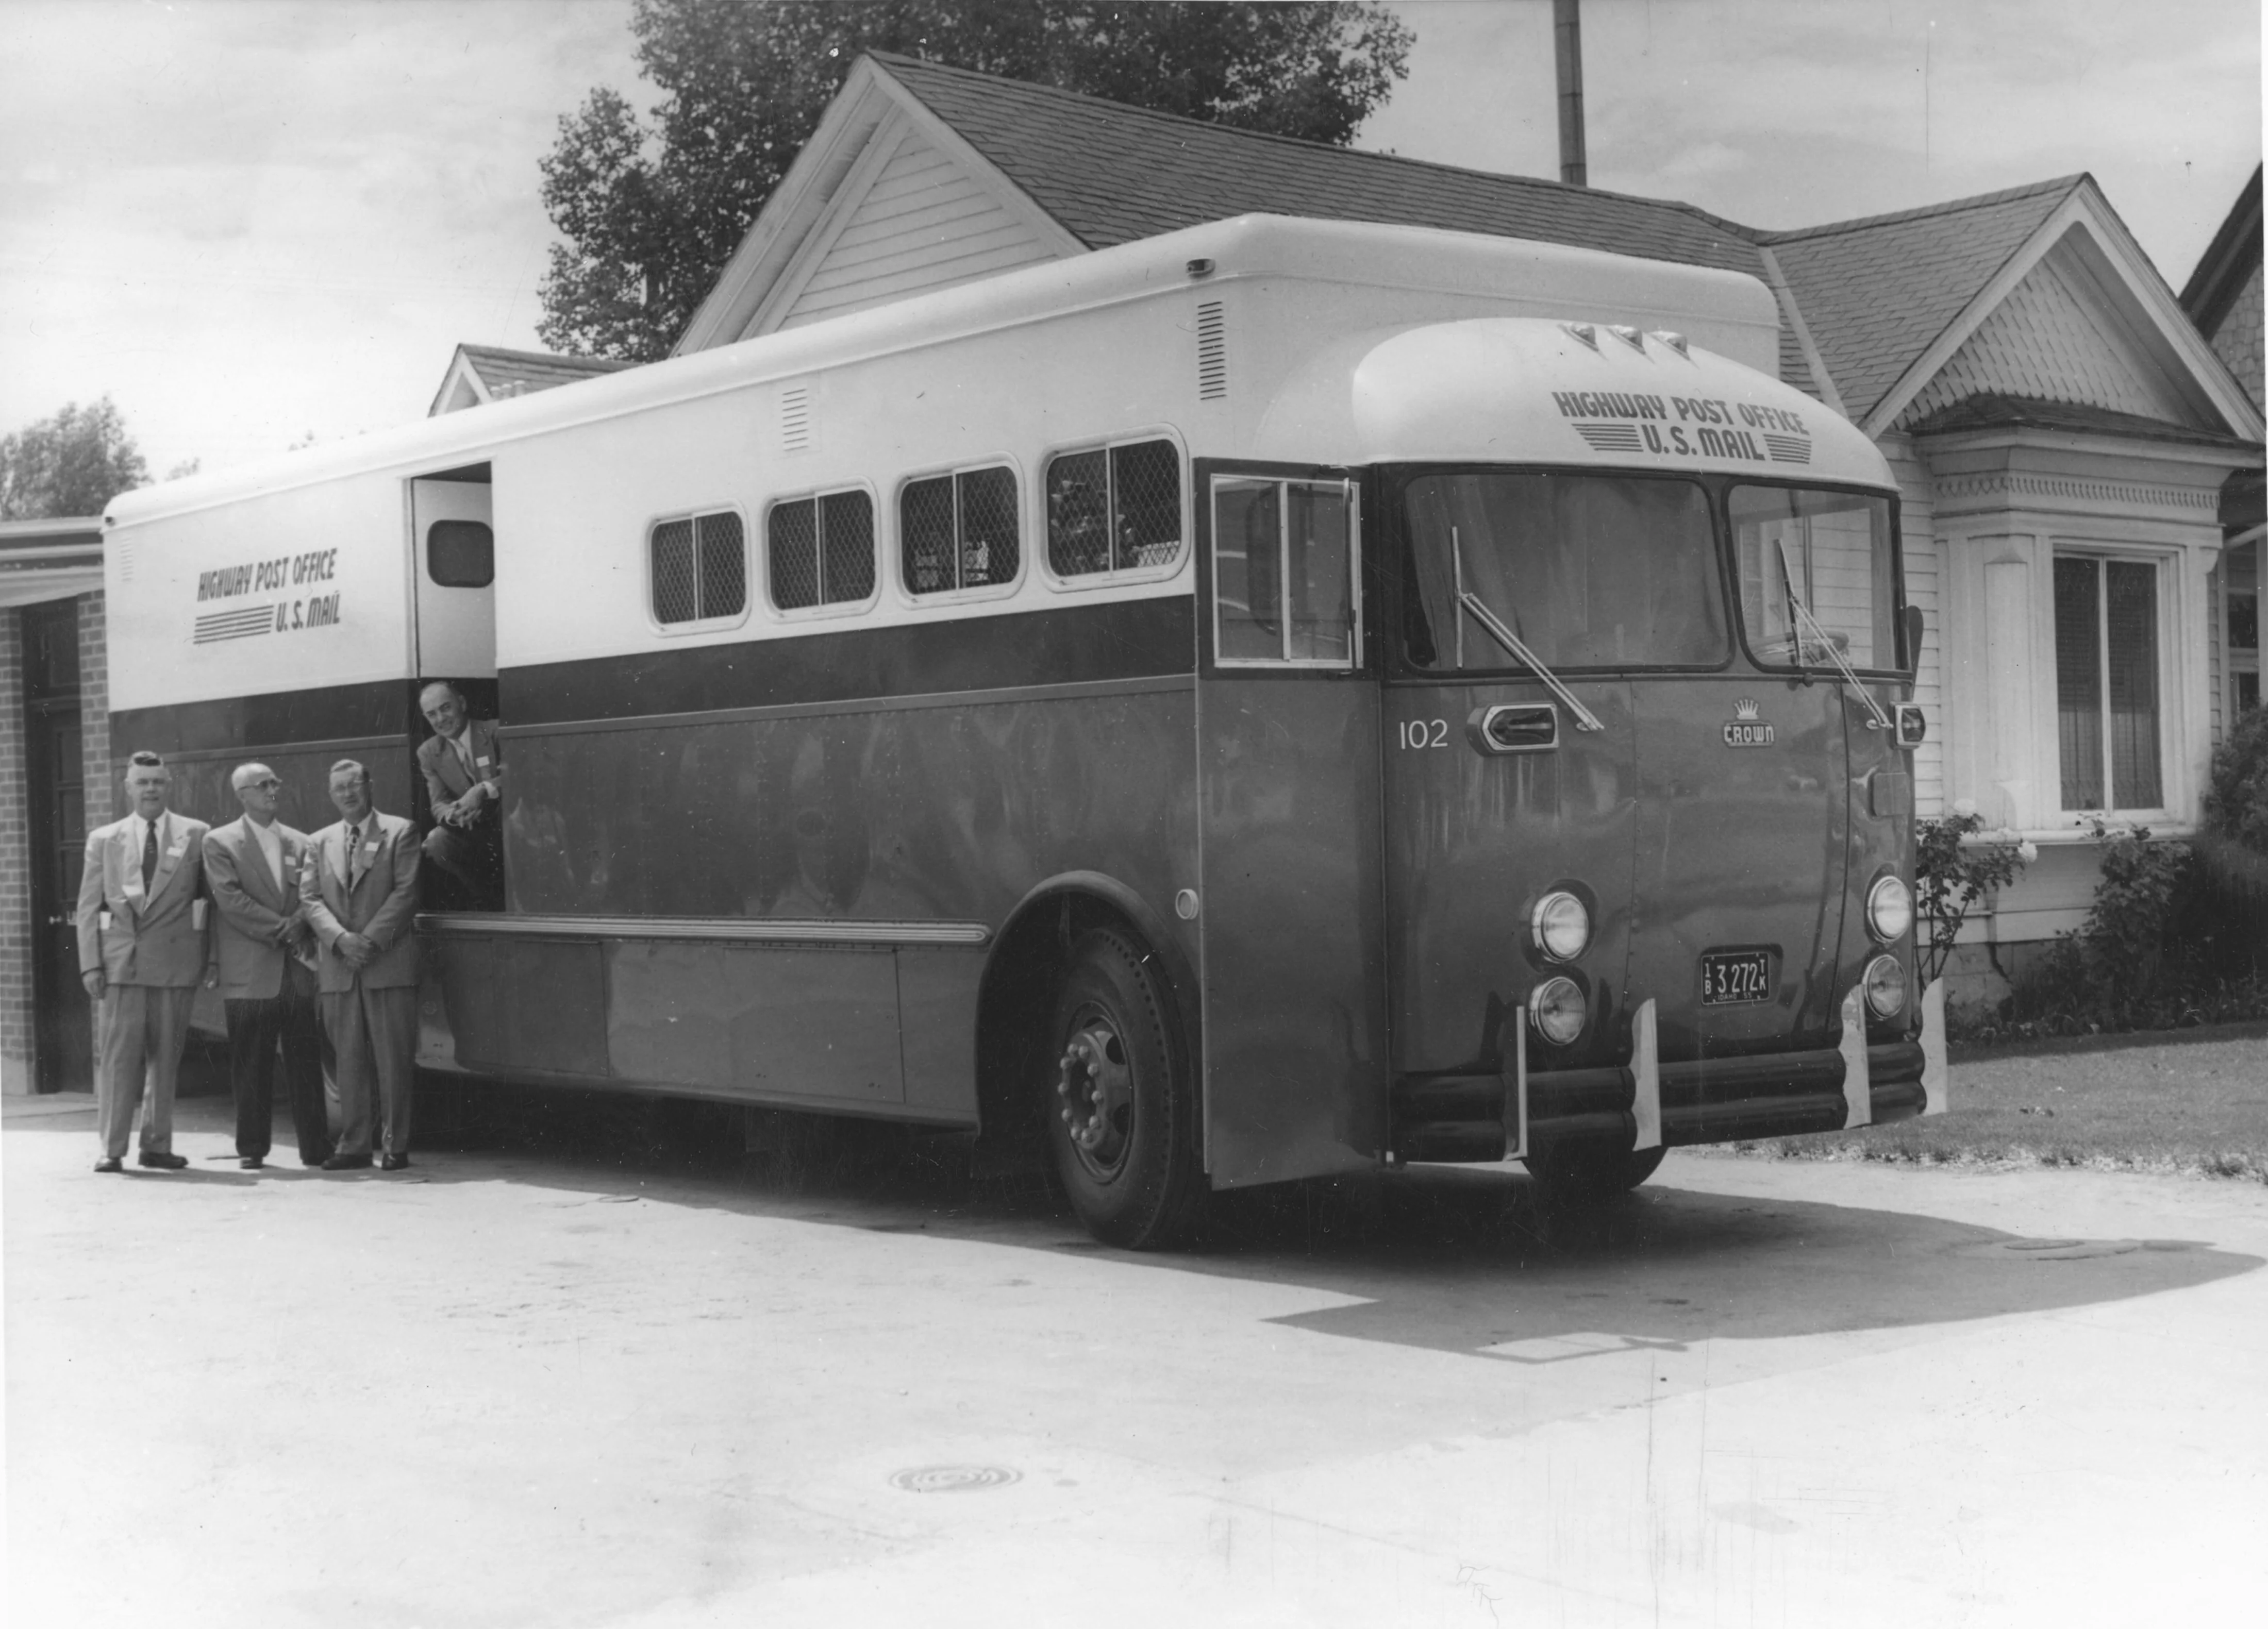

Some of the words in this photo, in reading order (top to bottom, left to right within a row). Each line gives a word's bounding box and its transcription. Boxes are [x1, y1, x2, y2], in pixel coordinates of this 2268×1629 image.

[1551, 391, 1667, 420] HIGHWAY
[1670, 396, 1736, 425] POST
[1737, 402, 1810, 436] OFFICE
[197, 563, 253, 602] HIGHWAY
[255, 557, 289, 592] POST
[293, 547, 338, 585] OFFICE
[1400, 719, 1448, 750] 102
[1723, 725, 1774, 743] CROWN
[1717, 993, 1737, 1001] IDAHO
